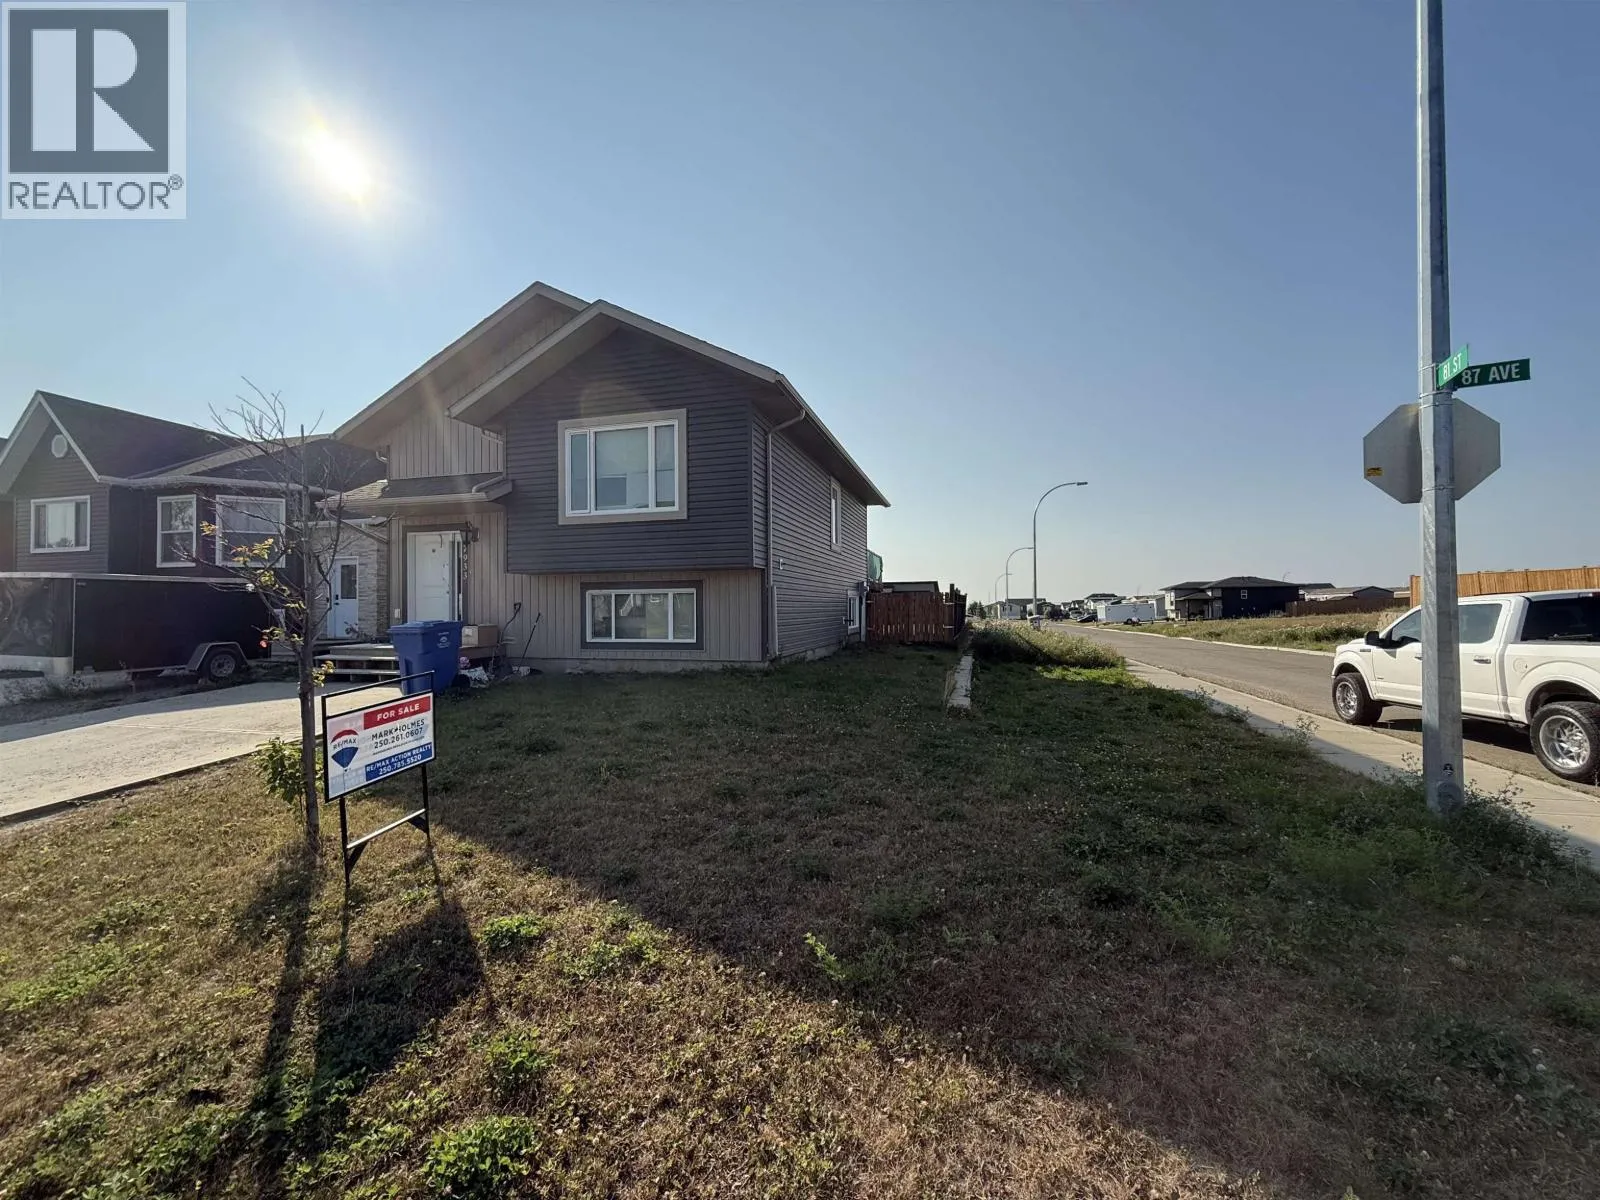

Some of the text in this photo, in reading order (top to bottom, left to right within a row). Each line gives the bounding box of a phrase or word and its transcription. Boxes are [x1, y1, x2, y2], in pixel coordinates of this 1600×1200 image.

[1443, 352, 1462, 380] 81 ST
[1461, 362, 1521, 385] 87 AVE
[377, 703, 420, 721] FOR SALE
[333, 738, 357, 750] RE/MAX
[371, 727, 395, 741] MARK
[374, 727, 423, 749] 250.261.0607
[366, 758, 390, 772] RE/MAX
[391, 752, 411, 763] ACTION
[411, 745, 432, 757] REALTY
